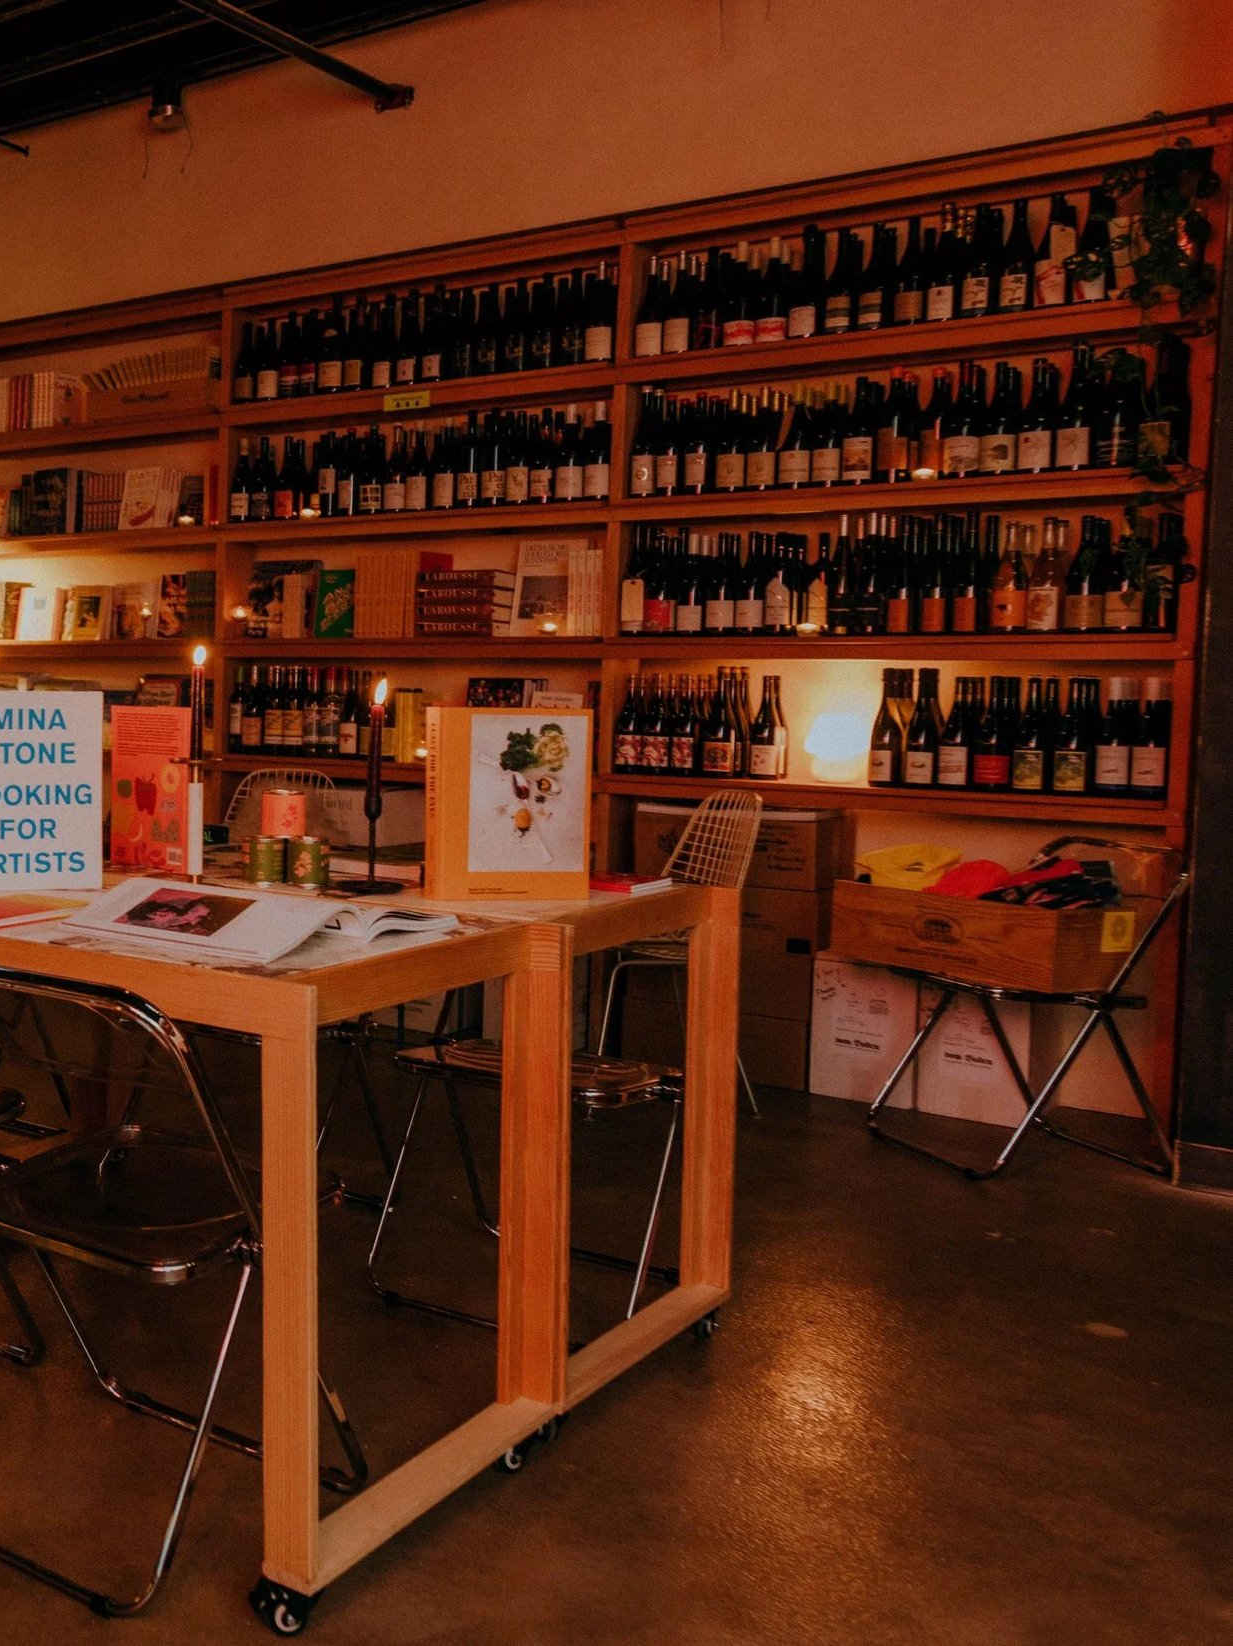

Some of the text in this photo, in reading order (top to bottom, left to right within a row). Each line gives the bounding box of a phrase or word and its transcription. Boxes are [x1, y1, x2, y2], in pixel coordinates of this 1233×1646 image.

[425, 572, 478, 580] LAROUSSE
[424, 588, 477, 598] LAROUSSE
[423, 605, 478, 615] LAROUSSE
[423, 623, 478, 632] LAROUSSE
[0, 818, 57, 840] FOR
